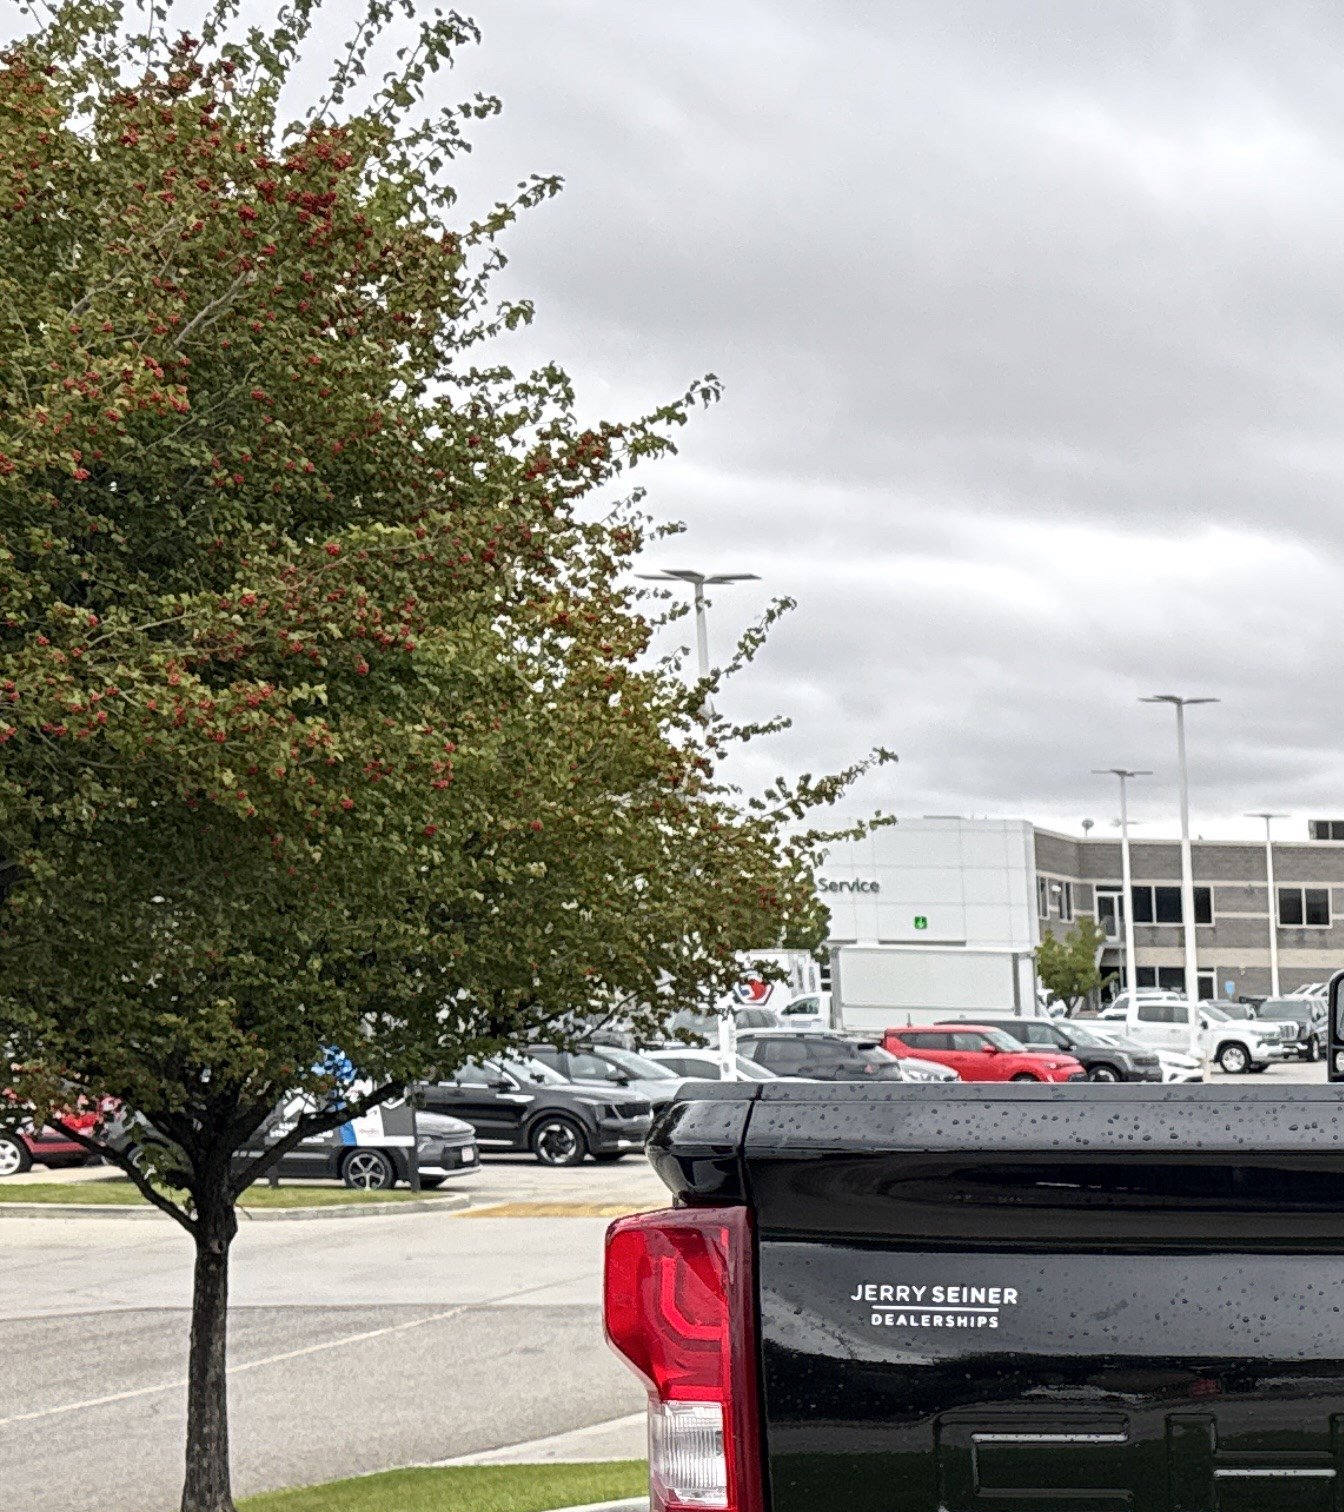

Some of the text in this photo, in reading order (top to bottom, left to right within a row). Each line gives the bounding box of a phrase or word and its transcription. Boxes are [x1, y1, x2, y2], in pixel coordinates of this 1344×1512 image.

[818, 877, 880, 893] Service
[850, 1284, 1018, 1305] JERRY SEINER
[871, 1313, 999, 1329] DEALERSHIPS
